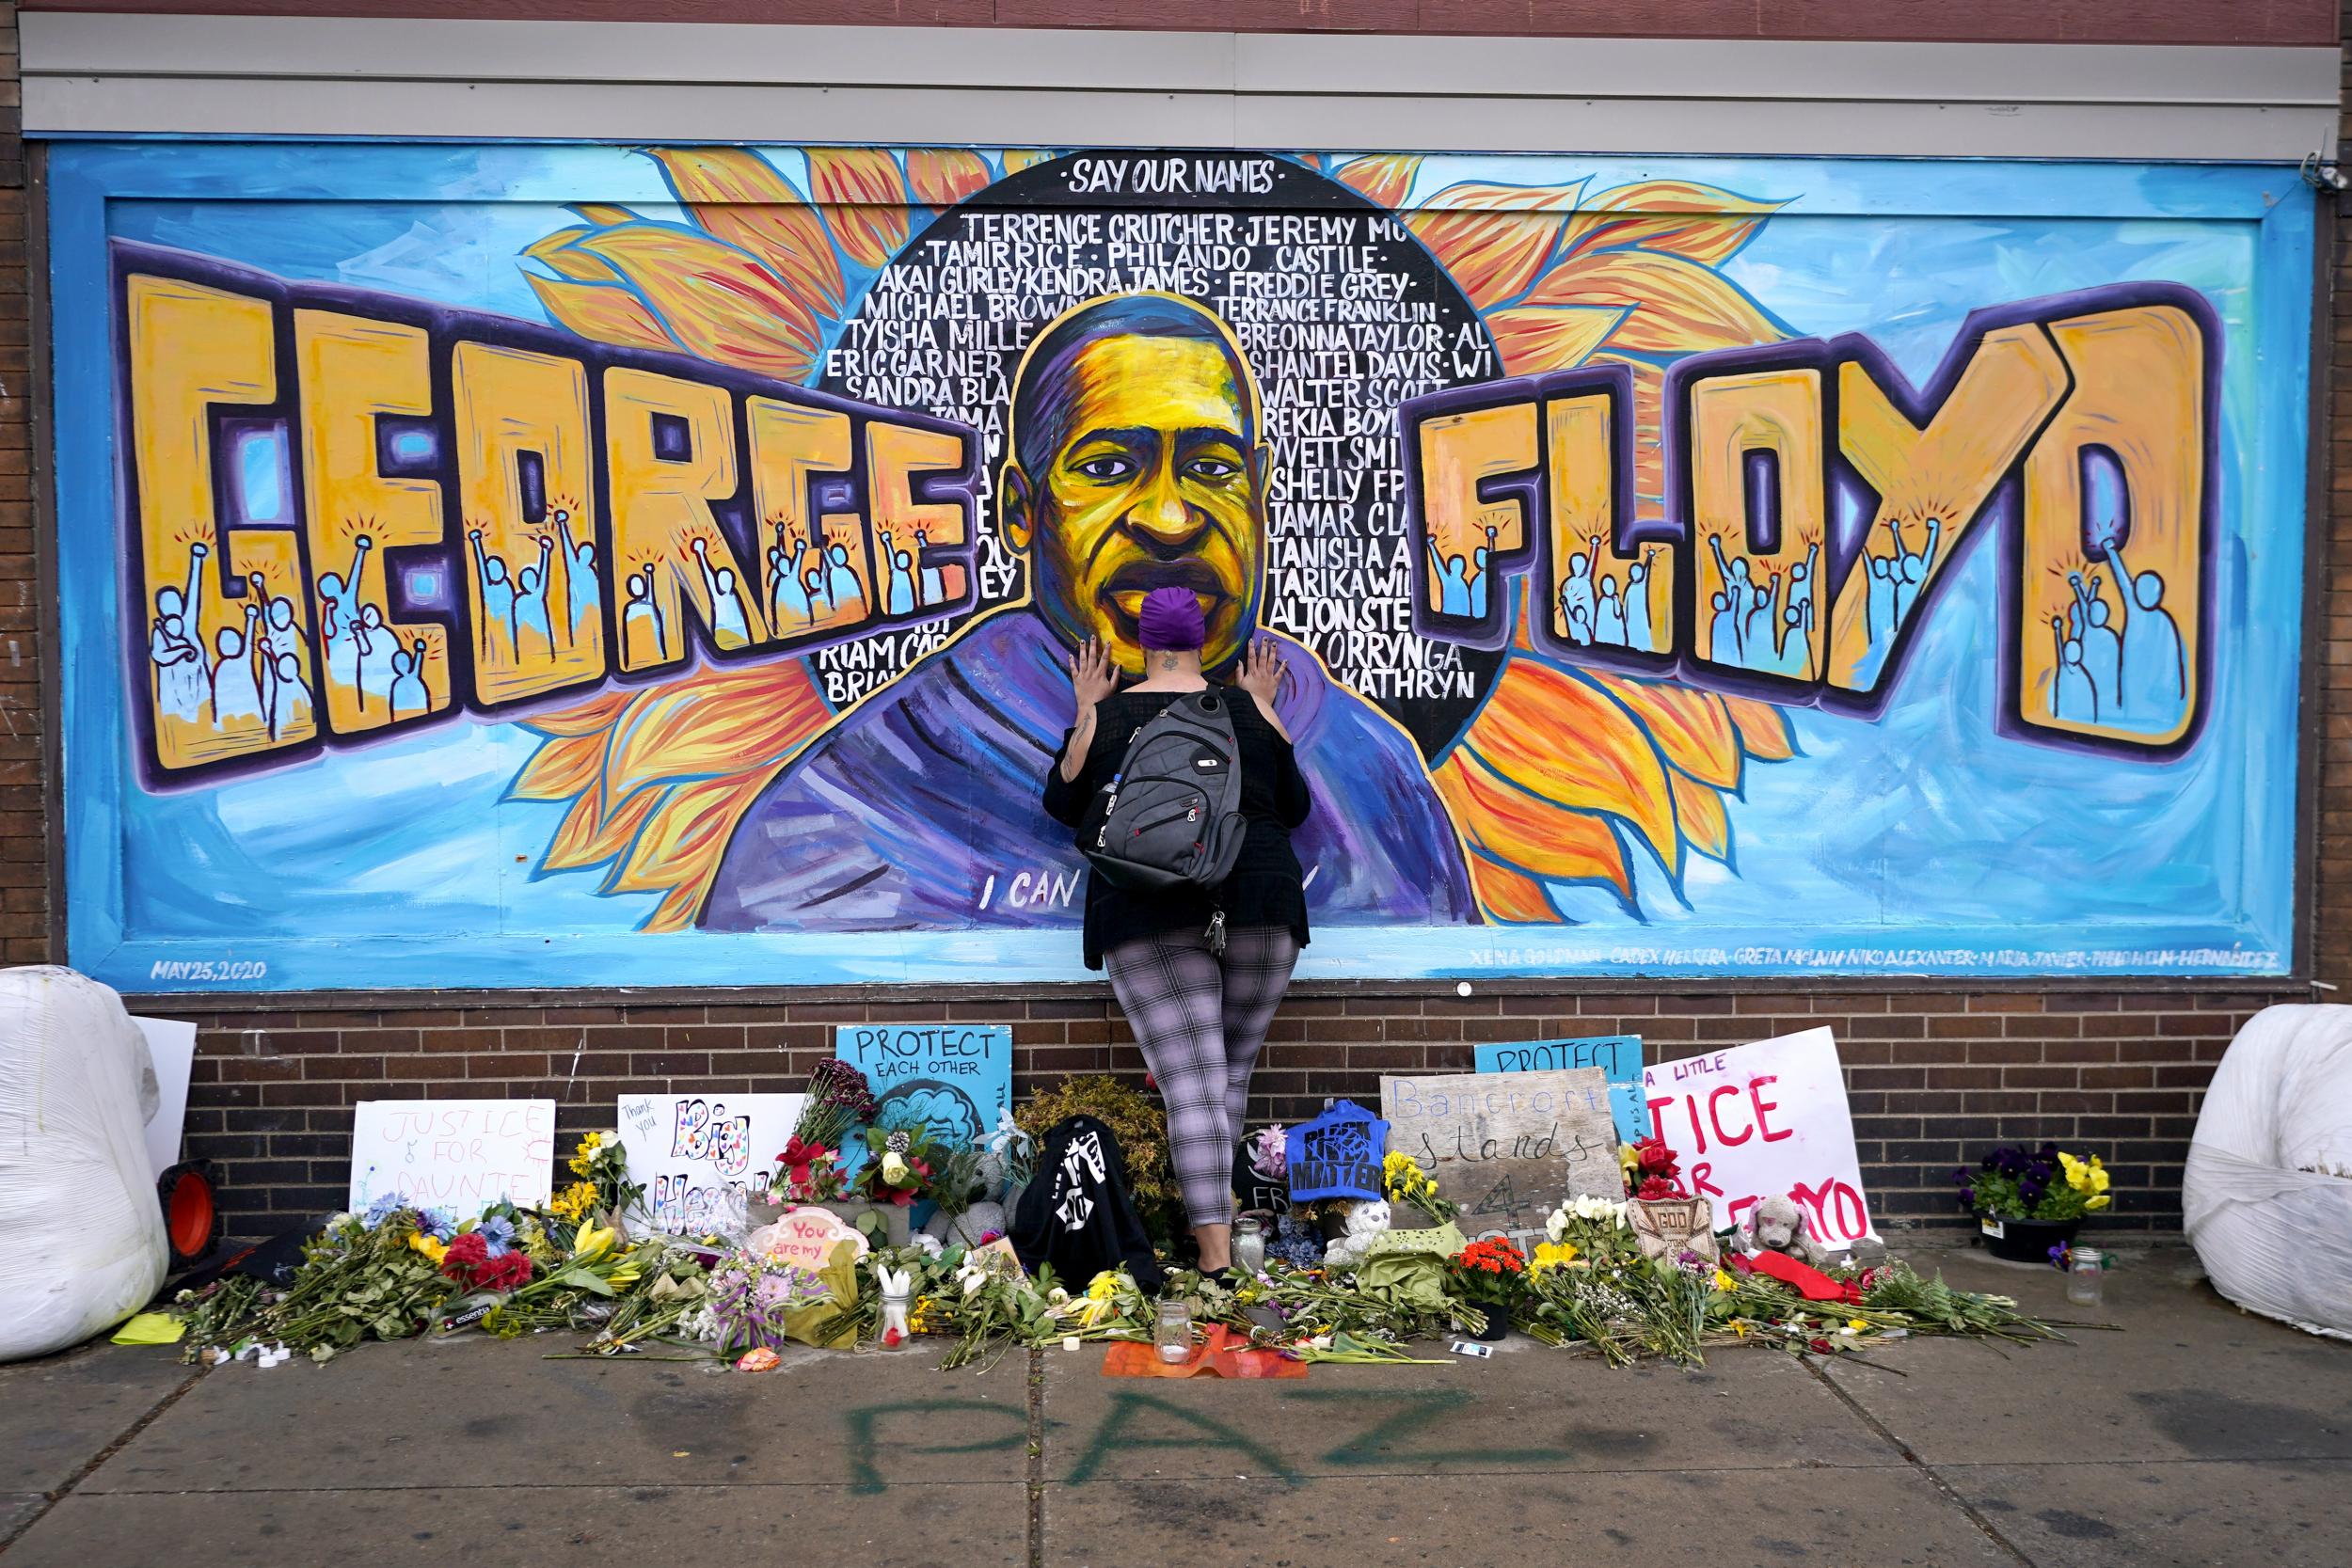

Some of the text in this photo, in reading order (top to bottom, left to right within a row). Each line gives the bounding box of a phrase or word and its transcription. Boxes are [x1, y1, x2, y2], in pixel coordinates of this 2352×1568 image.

[1069, 158, 1276, 194] SAY OUR NAMES
[960, 214, 1102, 245] TERRENCE
[1108, 214, 1235, 246] CRUTCHER
[1245, 215, 1357, 246] JEREMY
[925, 240, 1379, 275] TAMIR RICE PHILANDO CASTILE
[875, 264, 1410, 302] AKAI GURLEY KENDRA JAMES FREDDIE GREY
[864, 293, 981, 323] MICHAEL
[1211, 295, 1321, 323] TERRANCE
[1324, 298, 1437, 324] FRANKLIN
[845, 318, 940, 350] TYISHA
[948, 320, 1035, 352] MILLE
[1235, 322, 1347, 352] BREONNA
[1345, 324, 1446, 352] TAYLOR
[827, 349, 888, 378] ERIC
[893, 350, 1005, 379] GARNER
[1248, 350, 1365, 380] SHANTEL
[1366, 352, 1442, 380] DAVIS
[846, 376, 956, 407] SANDRA
[961, 376, 1012, 406] BLA
[1256, 378, 1363, 408] WALTER
[1261, 407, 1338, 437] REKIA
[1269, 467, 1364, 505] SHELLY
[122, 268, 973, 773] GEORGE
[1263, 501, 1362, 537] JAMAR
[1418, 303, 2202, 747] FLOYD
[1266, 536, 1385, 570] TANISHA
[1267, 567, 1368, 599] TARIKA
[1268, 596, 1357, 634] ALTON
[1341, 667, 1475, 701] KATHRYN
[1009, 868, 1081, 910] CAN
[855, 1028, 995, 1064] PROTECT
[875, 1059, 981, 1078] EACH OTHER
[1644, 1053, 1727, 1088] A LITTLE
[621, 1098, 656, 1121] Thank
[1392, 1079, 1598, 1118] Bancroft
[1646, 1074, 1794, 1155] TICE
[382, 1104, 548, 1143] JUSTICE
[670, 1098, 751, 1176] Big
[433, 1138, 487, 1164] FOR
[1410, 1121, 1604, 1170] stands
[1291, 1161, 1381, 1194] MATTER
[1470, 1174, 1534, 1229] 4
[792, 1221, 828, 1240] You
[1657, 1212, 1688, 1229] GOD
[773, 1242, 822, 1260] are my
[842, 1387, 1577, 1497] PAZ
